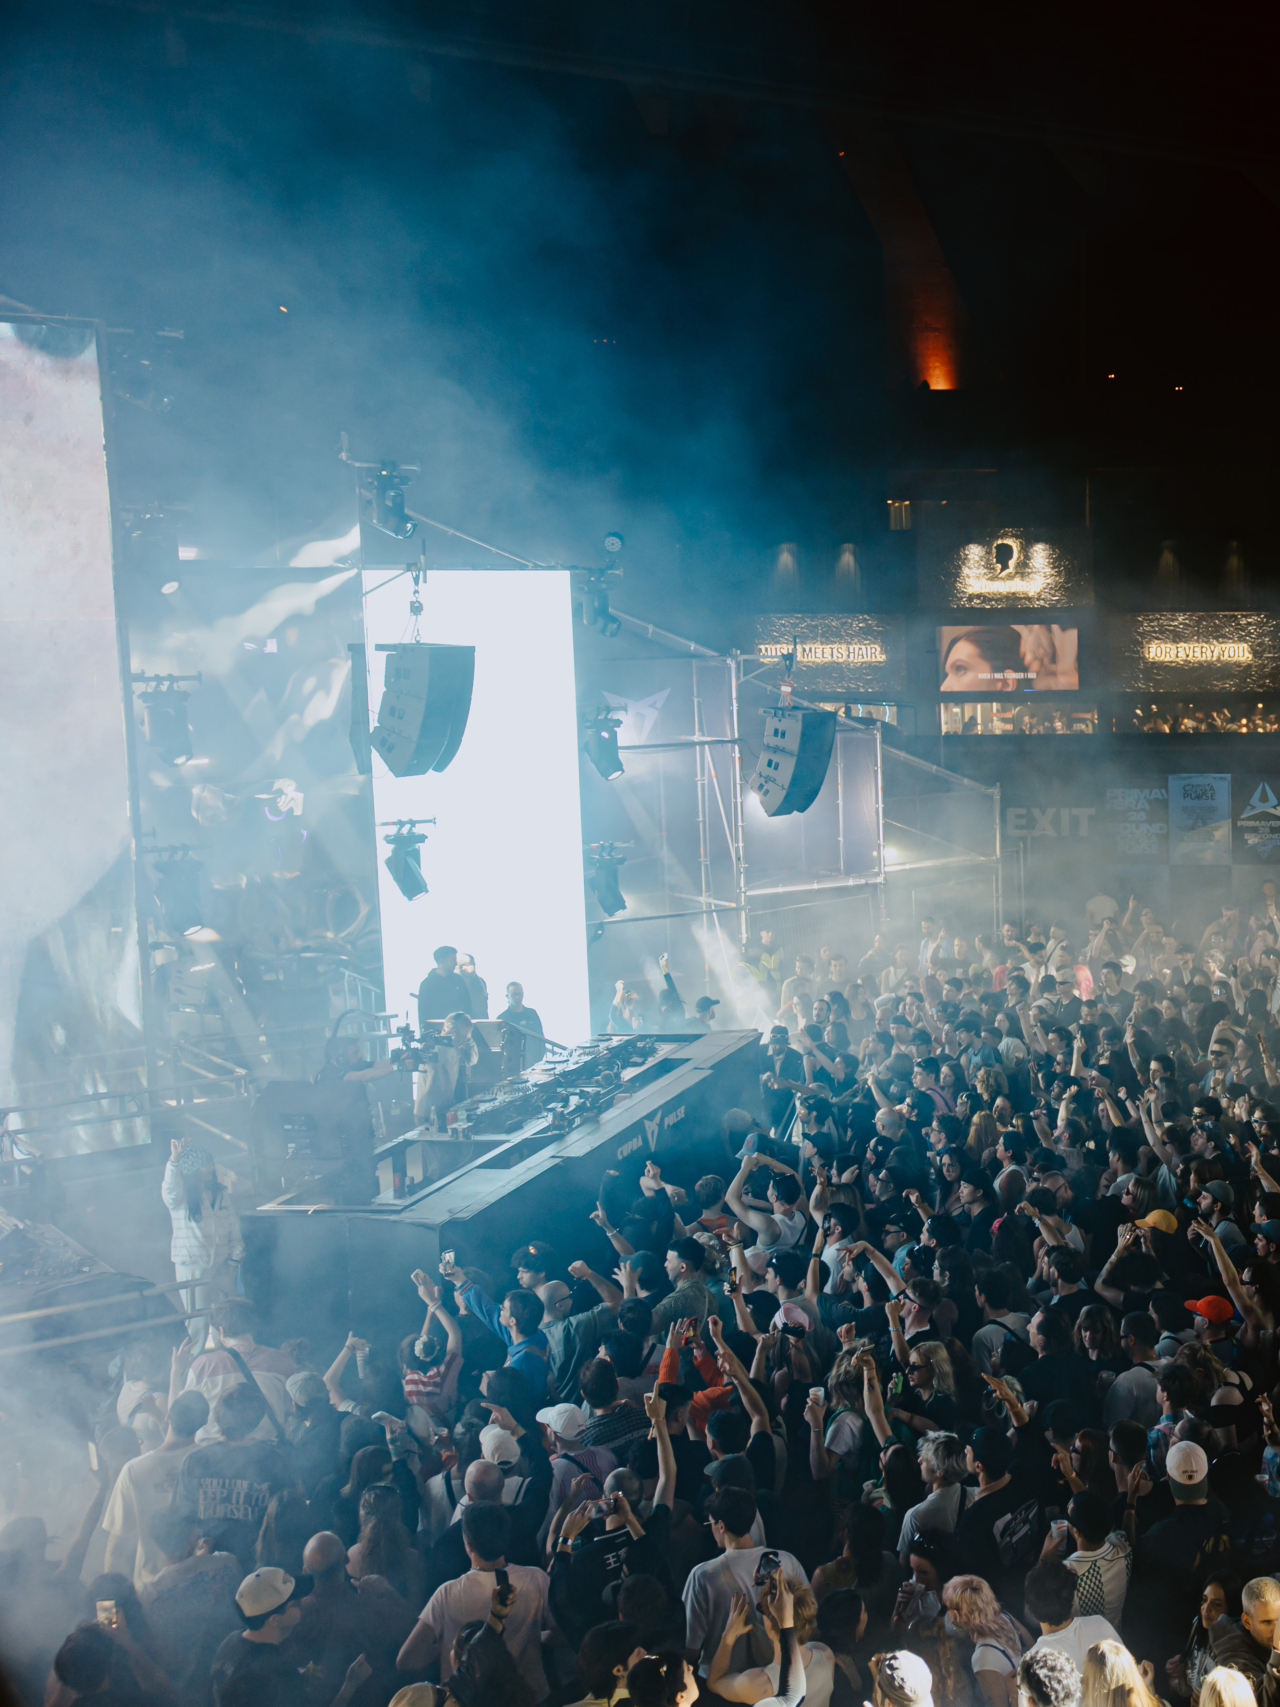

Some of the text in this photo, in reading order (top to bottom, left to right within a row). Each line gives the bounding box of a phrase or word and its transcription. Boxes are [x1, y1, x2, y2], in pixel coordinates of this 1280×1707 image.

[758, 646, 797, 659] MUSI
[802, 646, 844, 660] MEETS
[1147, 645, 1172, 659] FOR
[1175, 645, 1217, 659] EVERY
[1006, 807, 1096, 837] EXIT
[617, 1105, 686, 1160] CUPRA PULSE
